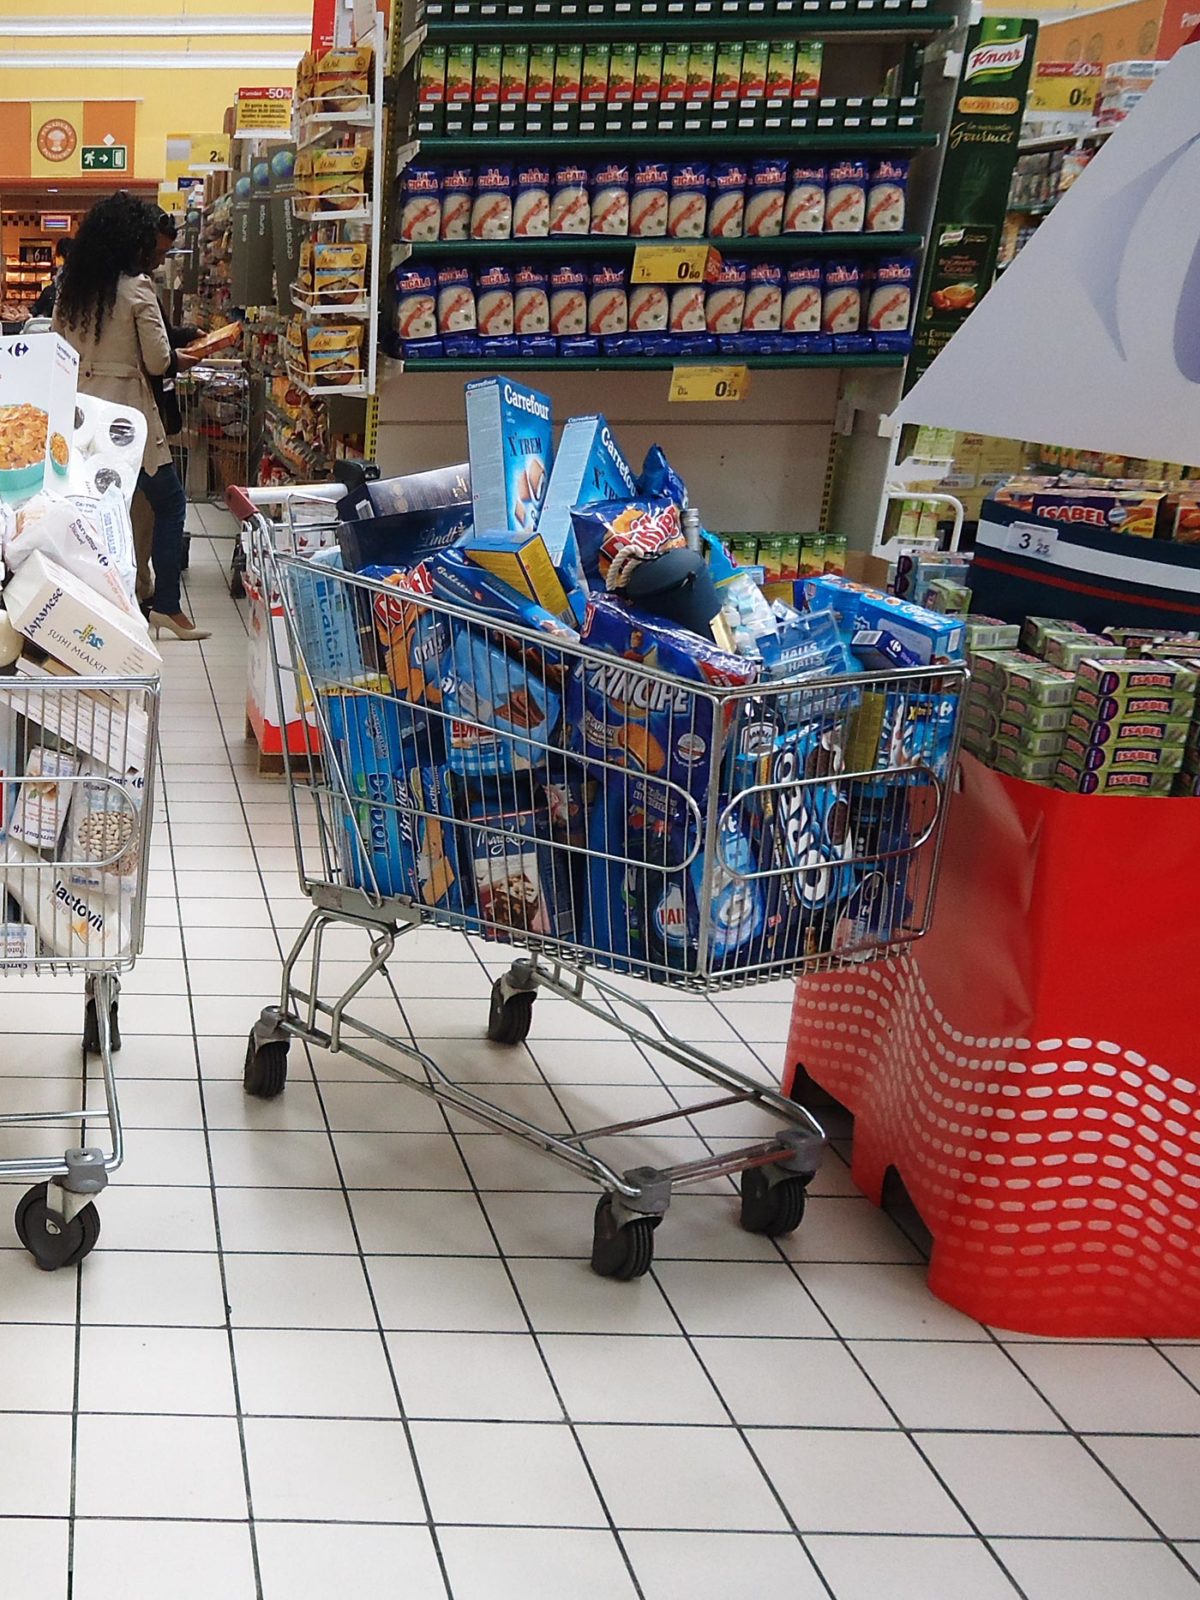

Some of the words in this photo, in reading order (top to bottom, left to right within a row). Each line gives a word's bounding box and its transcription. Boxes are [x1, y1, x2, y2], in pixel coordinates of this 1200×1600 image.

[970, 48, 1022, 69] Knorr
[504, 384, 550, 421] Carrefour
[601, 427, 637, 497] Carrefou
[1037, 504, 1107, 527] ISABEL
[419, 525, 457, 548] Lindt
[1018, 533, 1031, 550] 3
[1035, 542, 1050, 554] 25
[23, 587, 64, 638] Japanese
[48, 628, 72, 650] SUSHI
[71, 646, 108, 675] MEALKIT
[781, 641, 818, 660] HALLS
[788, 654, 825, 673] HALLS
[1129, 674, 1172, 688] ISABEL
[1129, 700, 1170, 713] ISABEL
[1121, 725, 1162, 739] ISABEL
[1115, 751, 1158, 763] ISABEL
[1108, 774, 1150, 787] ISABEL
[776, 750, 830, 903] OREO
[55, 880, 104, 932] lactovit
